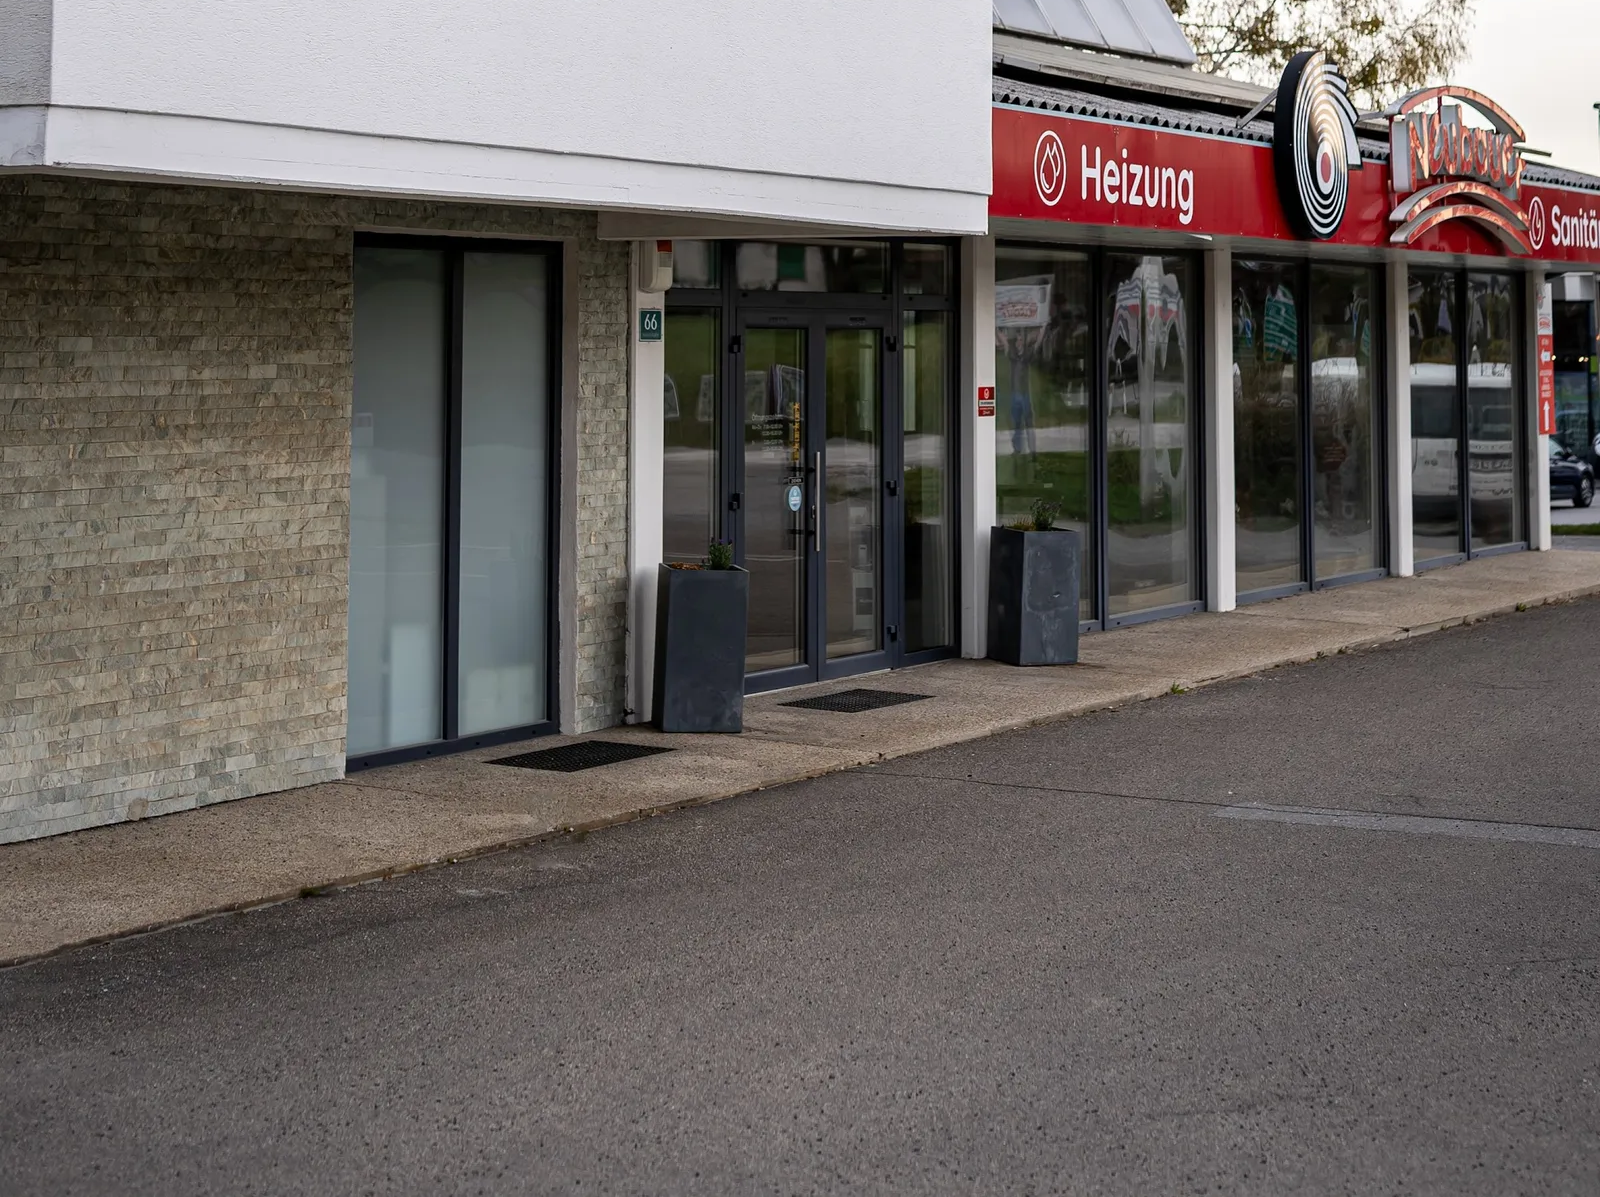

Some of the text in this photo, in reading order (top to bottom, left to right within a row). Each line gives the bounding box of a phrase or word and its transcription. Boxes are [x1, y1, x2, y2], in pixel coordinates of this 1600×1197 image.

[1081, 144, 1194, 225] Heizung
[1551, 204, 1600, 250] Sanitä
[644, 313, 658, 331] 66
